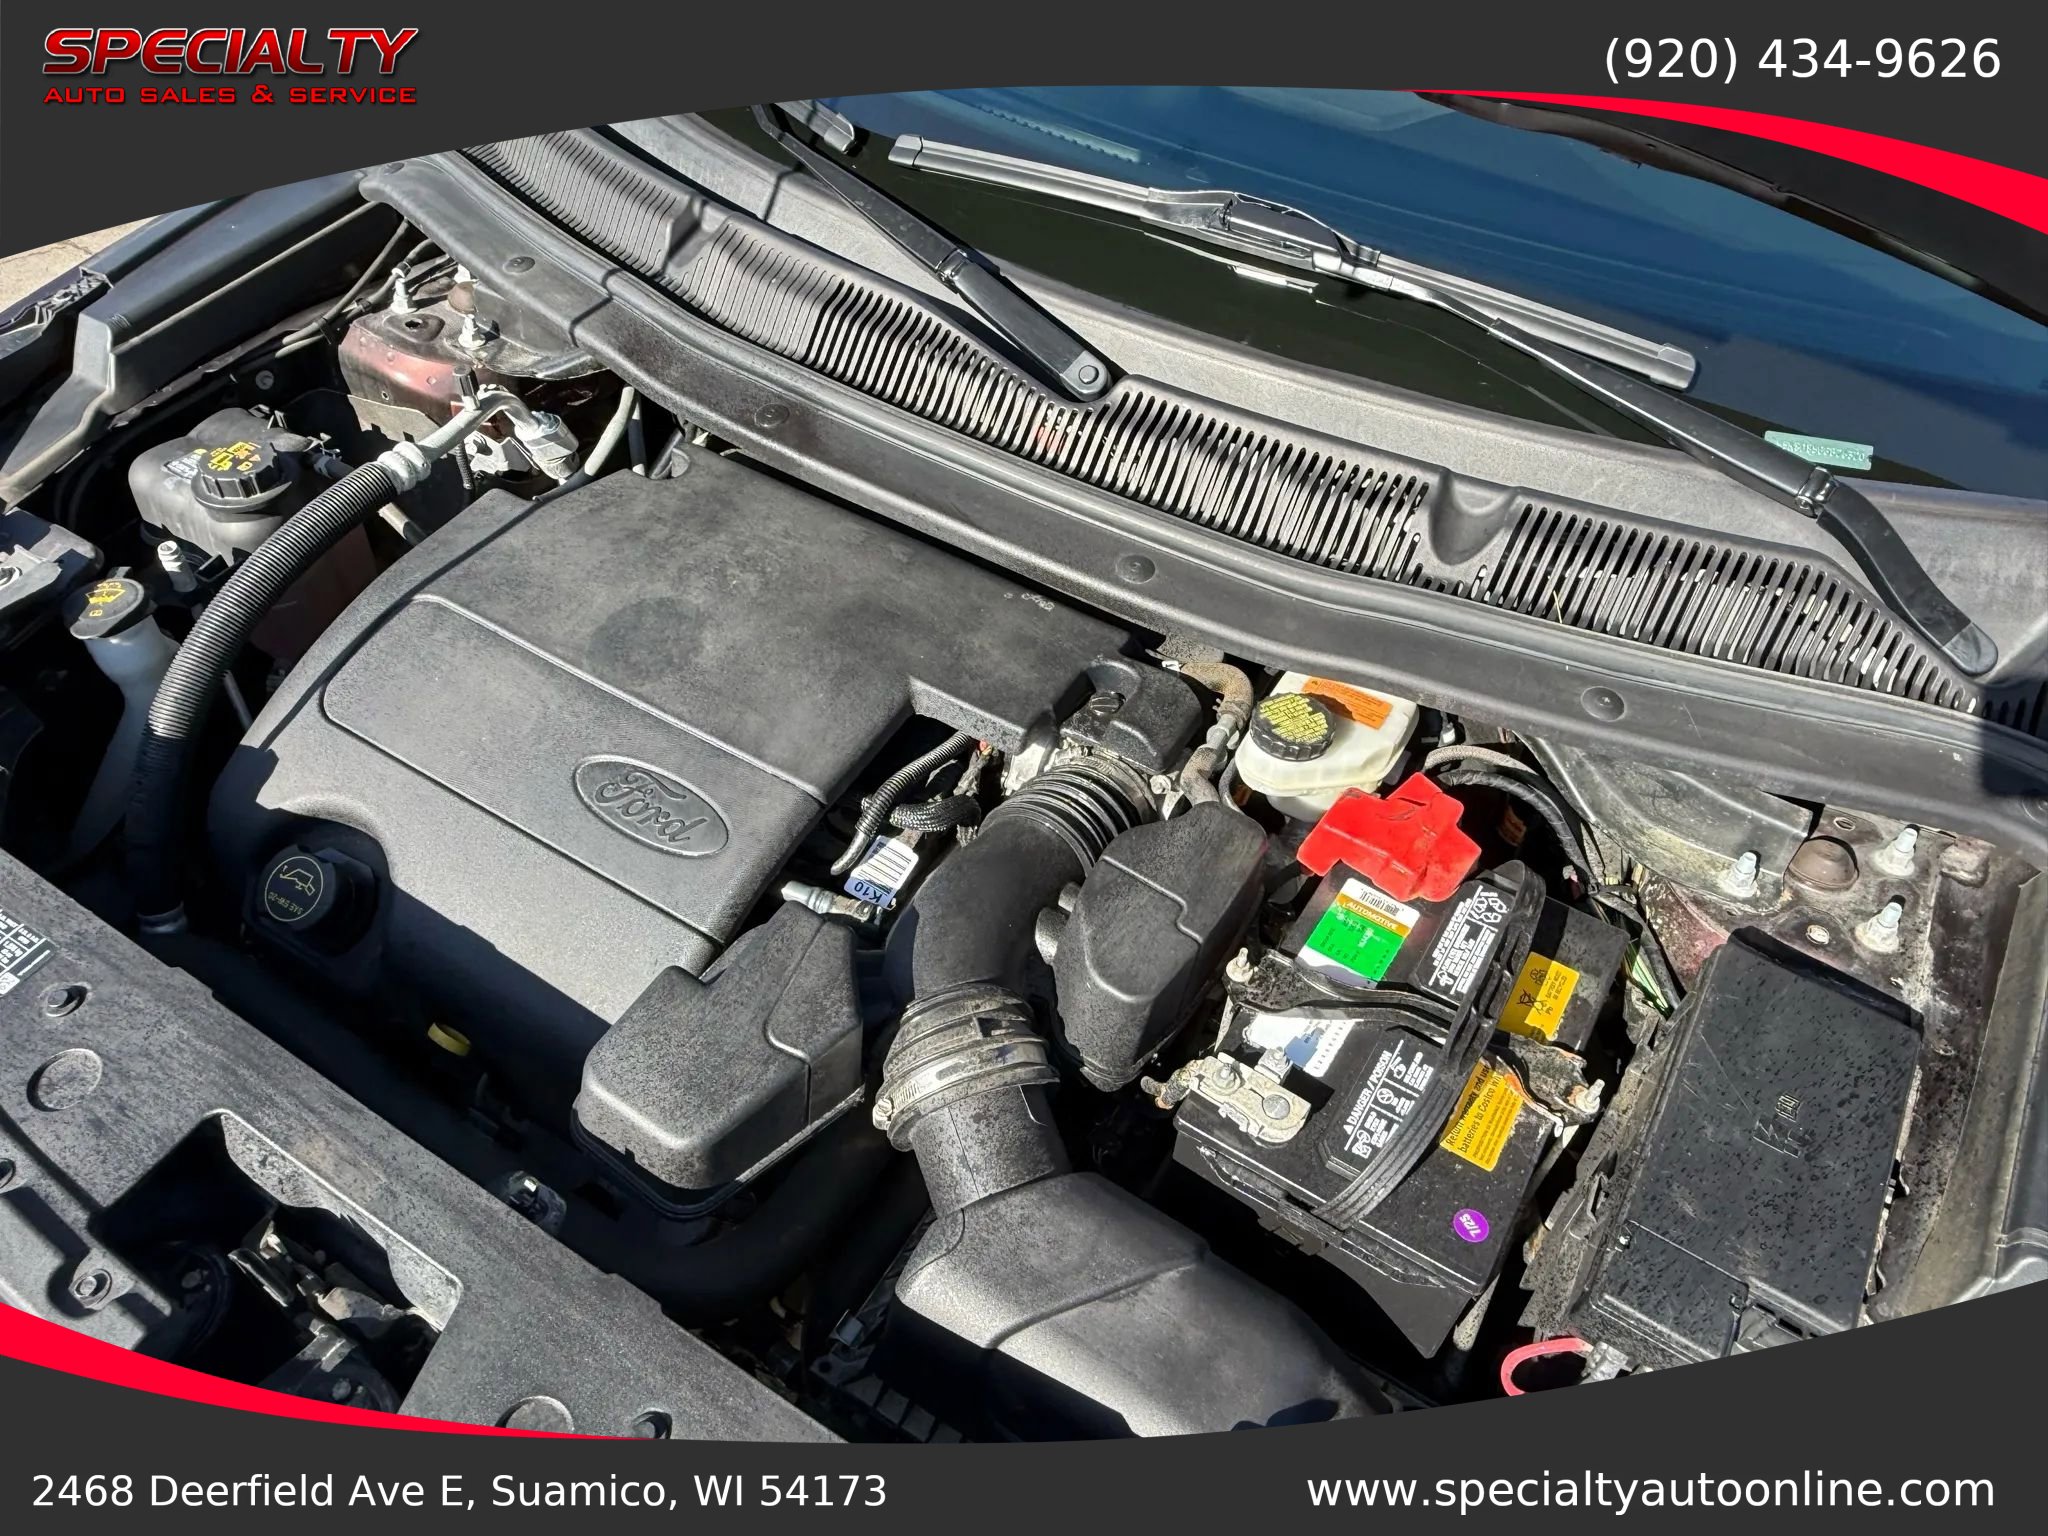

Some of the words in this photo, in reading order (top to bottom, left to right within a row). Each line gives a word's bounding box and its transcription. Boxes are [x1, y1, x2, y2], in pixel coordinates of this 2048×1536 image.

[594, 770, 708, 843] Ford
[854, 881, 883, 903] K10
[1344, 901, 1398, 931] AUTOMOTIVE
[1346, 1087, 1373, 1126] DANGER
[1368, 1050, 1393, 1084] POISON
[1478, 1088, 1496, 1113] Costco
[1445, 1119, 1465, 1146] Return
[1474, 1077, 1485, 1092] and
[1474, 1112, 1484, 1122] to
[1458, 1120, 1481, 1153] batteries
[1459, 1213, 1482, 1238] 7/25
